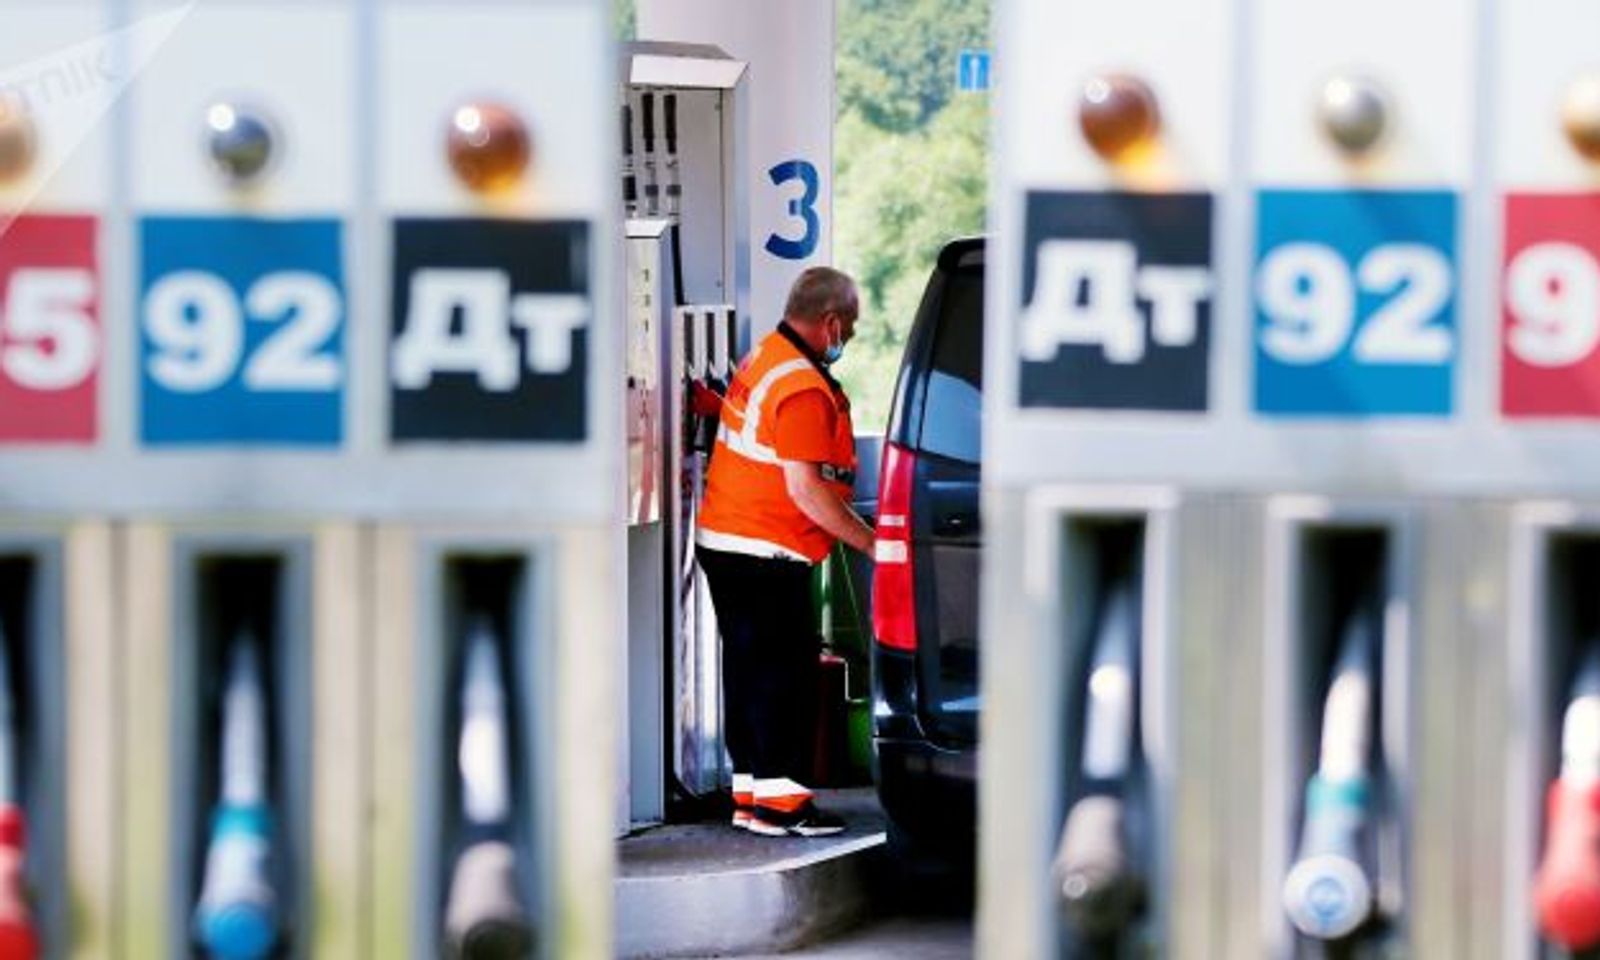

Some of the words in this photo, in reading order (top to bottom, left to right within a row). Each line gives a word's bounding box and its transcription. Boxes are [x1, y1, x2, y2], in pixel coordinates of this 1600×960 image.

[766, 161, 819, 259] 3
[0, 267, 97, 390] 5
[143, 270, 342, 392] 92
[391, 267, 591, 390] Дт
[1019, 238, 1213, 363] Дт
[1258, 241, 1453, 364] 92
[1504, 242, 1600, 366] 9
